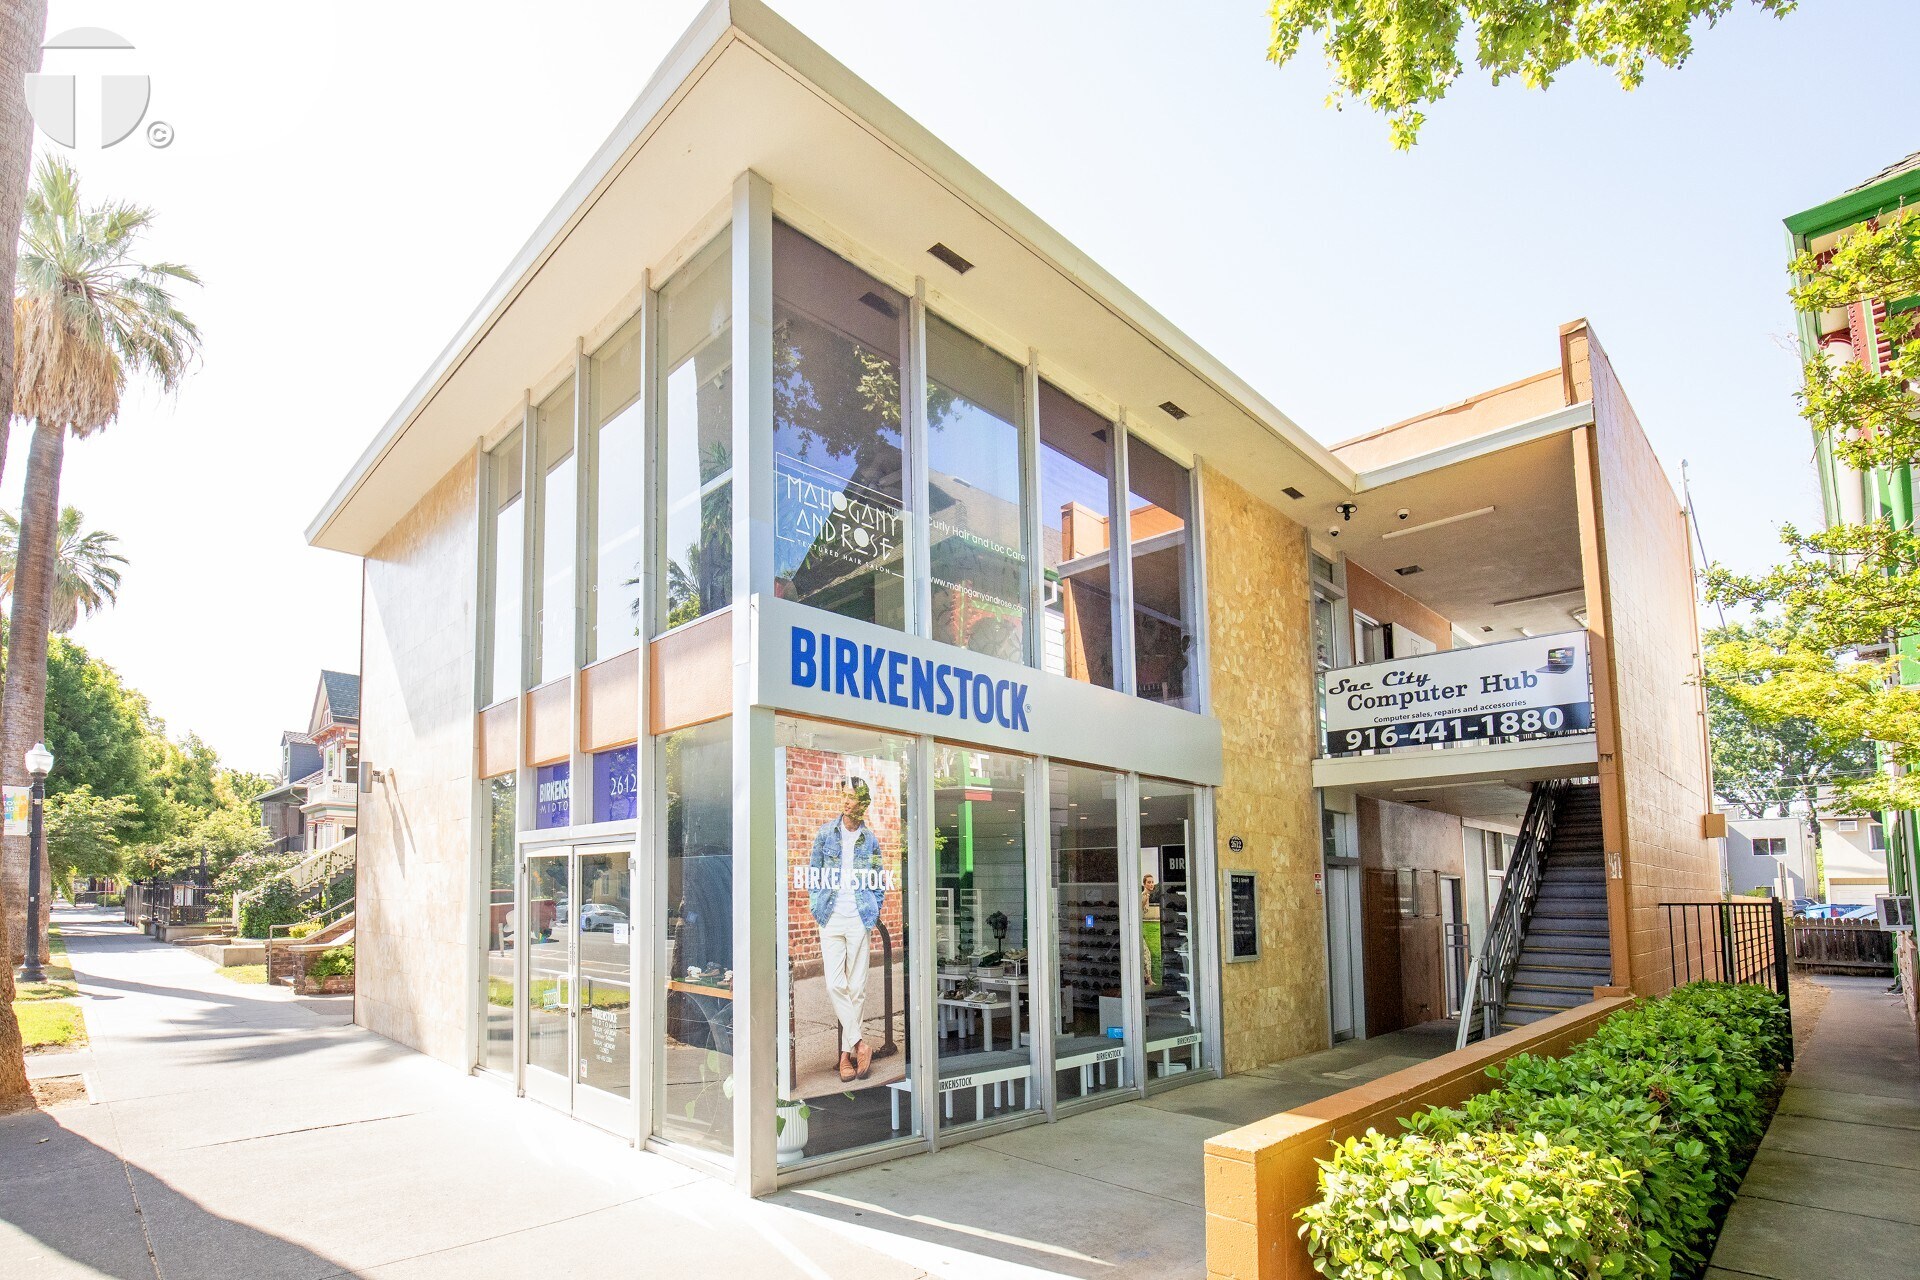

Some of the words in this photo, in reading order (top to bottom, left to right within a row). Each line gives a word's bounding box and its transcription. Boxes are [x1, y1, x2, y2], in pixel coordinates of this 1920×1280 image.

[787, 473, 899, 537] MAHOGANY
[796, 508, 836, 542] AND
[840, 523, 895, 561] ROSE
[952, 526, 970, 540] Hair
[972, 536, 988, 548] and
[991, 541, 1004, 553] Loc
[1006, 548, 1025, 562] Care
[798, 539, 839, 558] TEXTURED
[843, 555, 862, 566] HAIR
[866, 560, 890, 575] SALON
[791, 625, 1030, 733] BIRKENSTOCK
[1328, 678, 1374, 695] Sac
[1381, 670, 1431, 688] City
[1347, 684, 1468, 711] Computer
[1479, 670, 1538, 694] Hub
[1345, 707, 1564, 750] 916-441-1880
[1373, 713, 1411, 724] Computer
[1411, 711, 1433, 720] sales,
[1434, 707, 1462, 717] repairs
[1463, 704, 1478, 713] and
[1480, 699, 1527, 710] accessories
[610, 773, 637, 796] 2612
[793, 865, 895, 891] BIRKENSTOCK
[1096, 1048, 1122, 1061] BIRKENSTOCK
